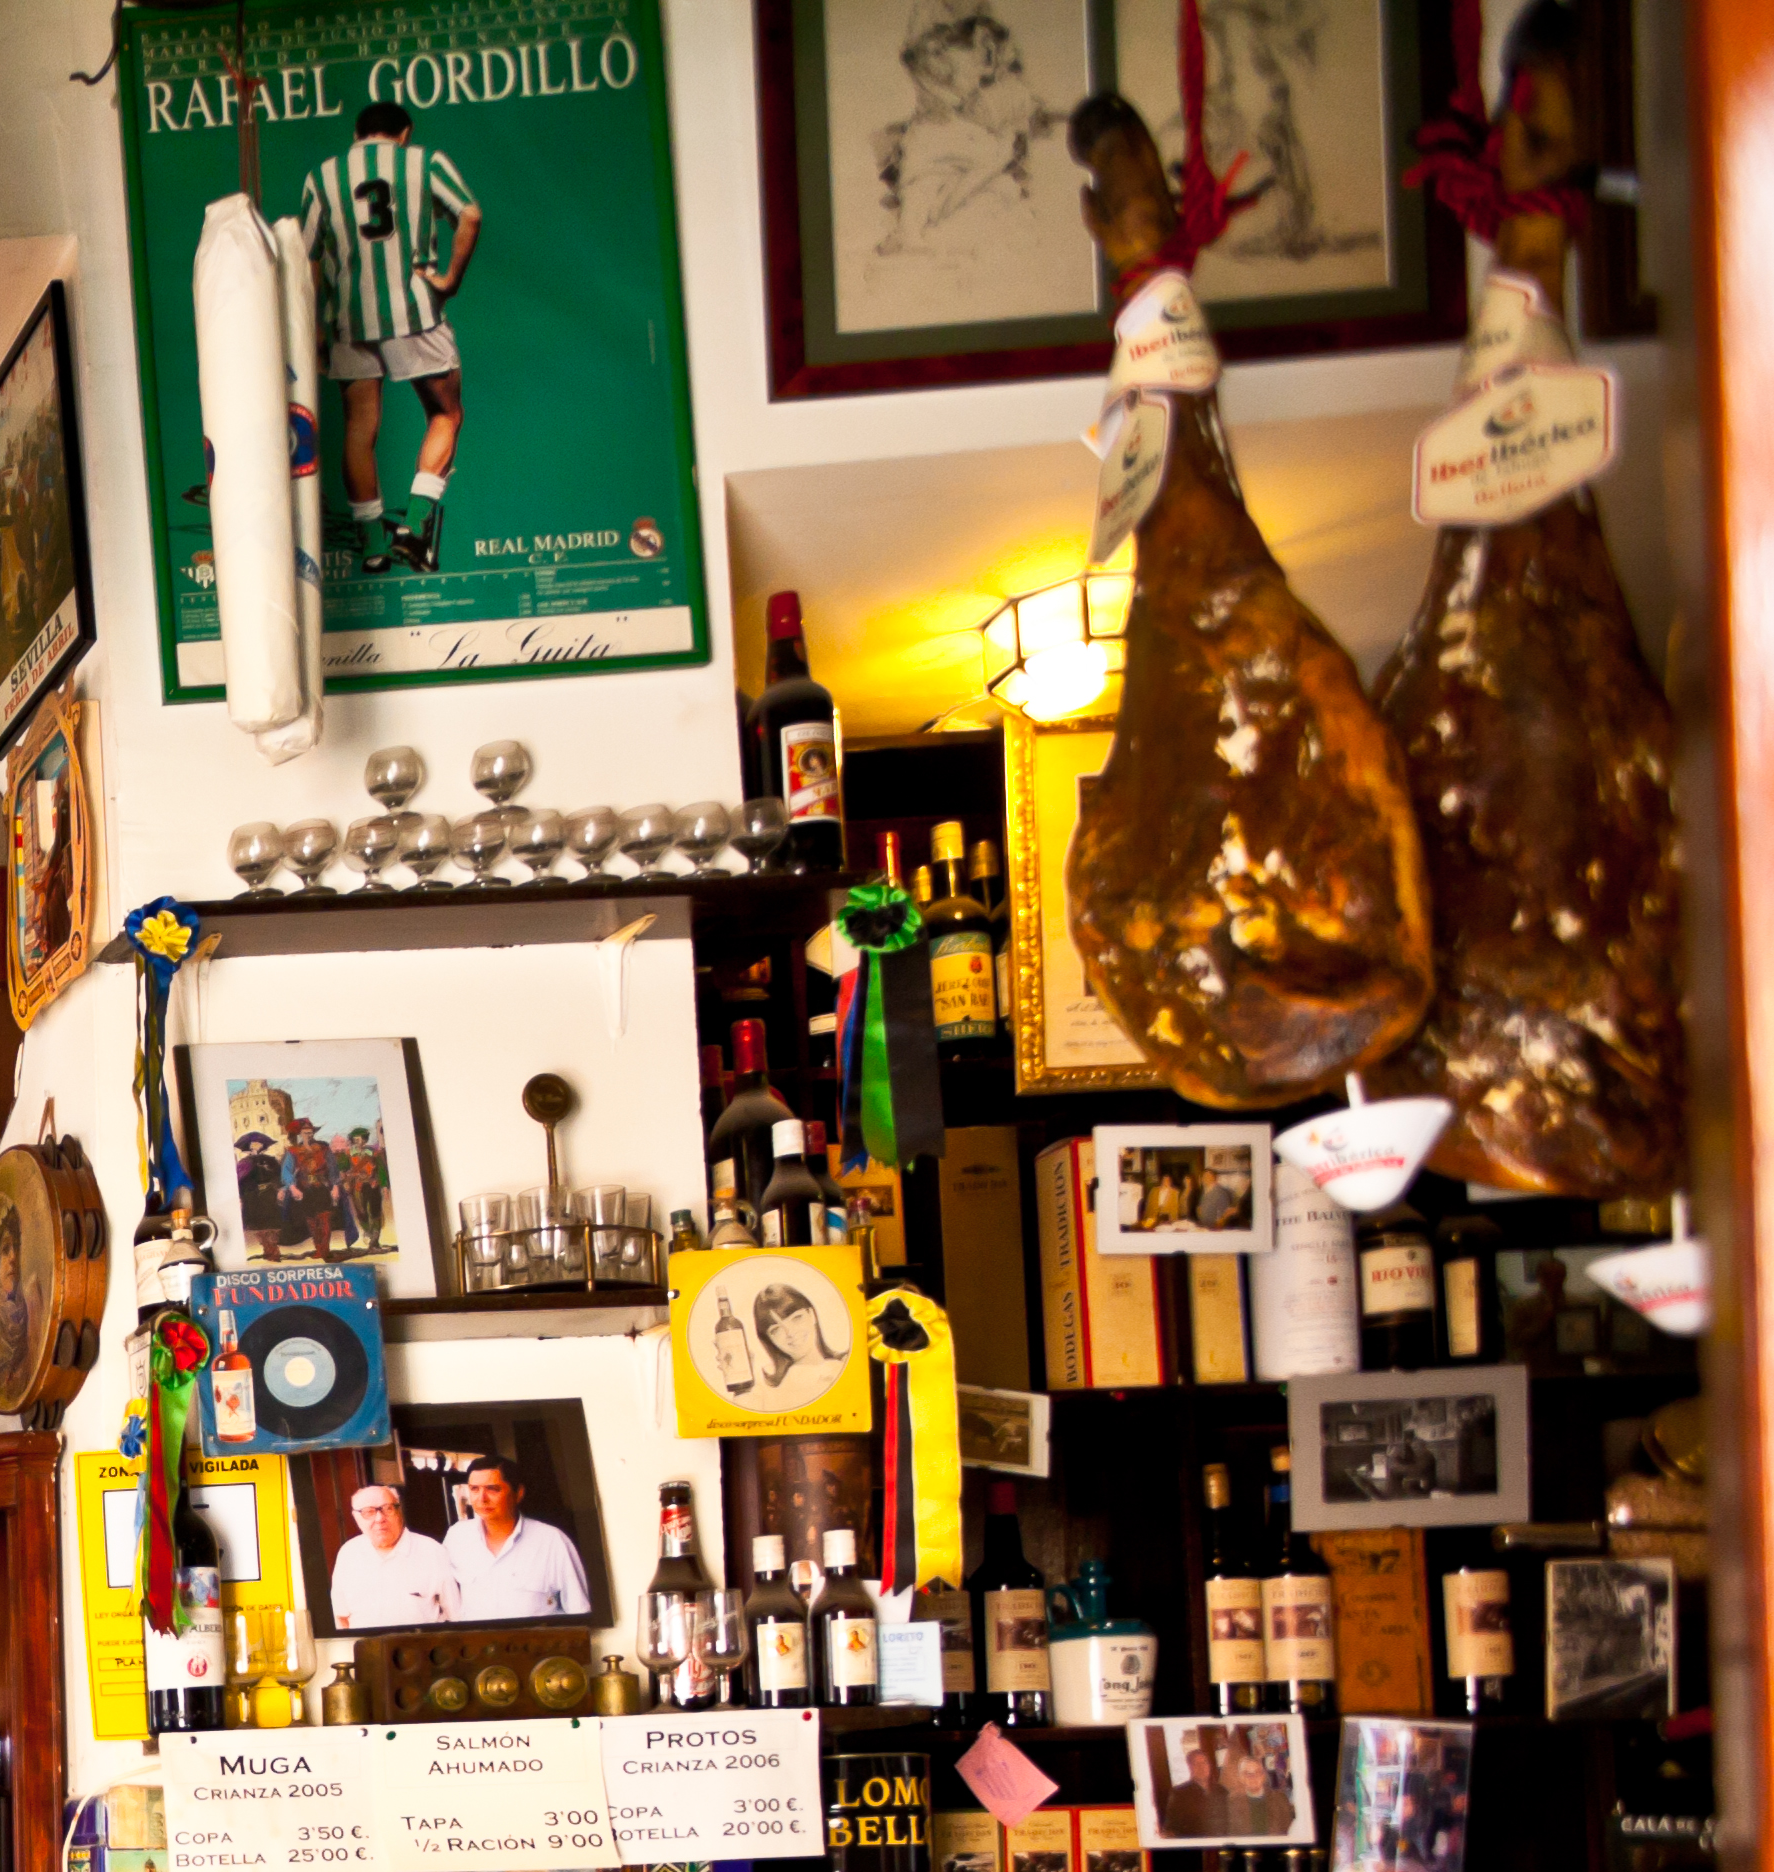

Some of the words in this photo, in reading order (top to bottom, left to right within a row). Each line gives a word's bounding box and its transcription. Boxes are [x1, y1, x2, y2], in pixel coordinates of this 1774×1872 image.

[147, 63, 344, 134] RAFAEL
[368, 36, 638, 110] GORDILLO
[354, 178, 396, 241] 3
[474, 537, 529, 558] REAL
[533, 529, 621, 552] MADRID
[11, 613, 63, 693] SEVILLA
[429, 628, 482, 667] La
[505, 620, 614, 665] Guita
[4, 681, 29, 721] FERIA
[31, 659, 45, 685] DE
[47, 622, 73, 666] ABRIL
[216, 1272, 261, 1288] DISCO
[267, 1267, 343, 1284] SORPRESA
[213, 1280, 354, 1306] FUNDADOR
[189, 1459, 259, 1474] VIGILADA
[723, 1751, 781, 1771] 2006
[287, 1782, 344, 1800] 2005
[733, 1797, 781, 1814] 3'00
[543, 1808, 599, 1828] 3'00
[297, 1825, 347, 1842] 3'50
[721, 1820, 785, 1839] 20'00
[548, 1832, 604, 1851] 9'00
[288, 1845, 349, 1864] 25'00
